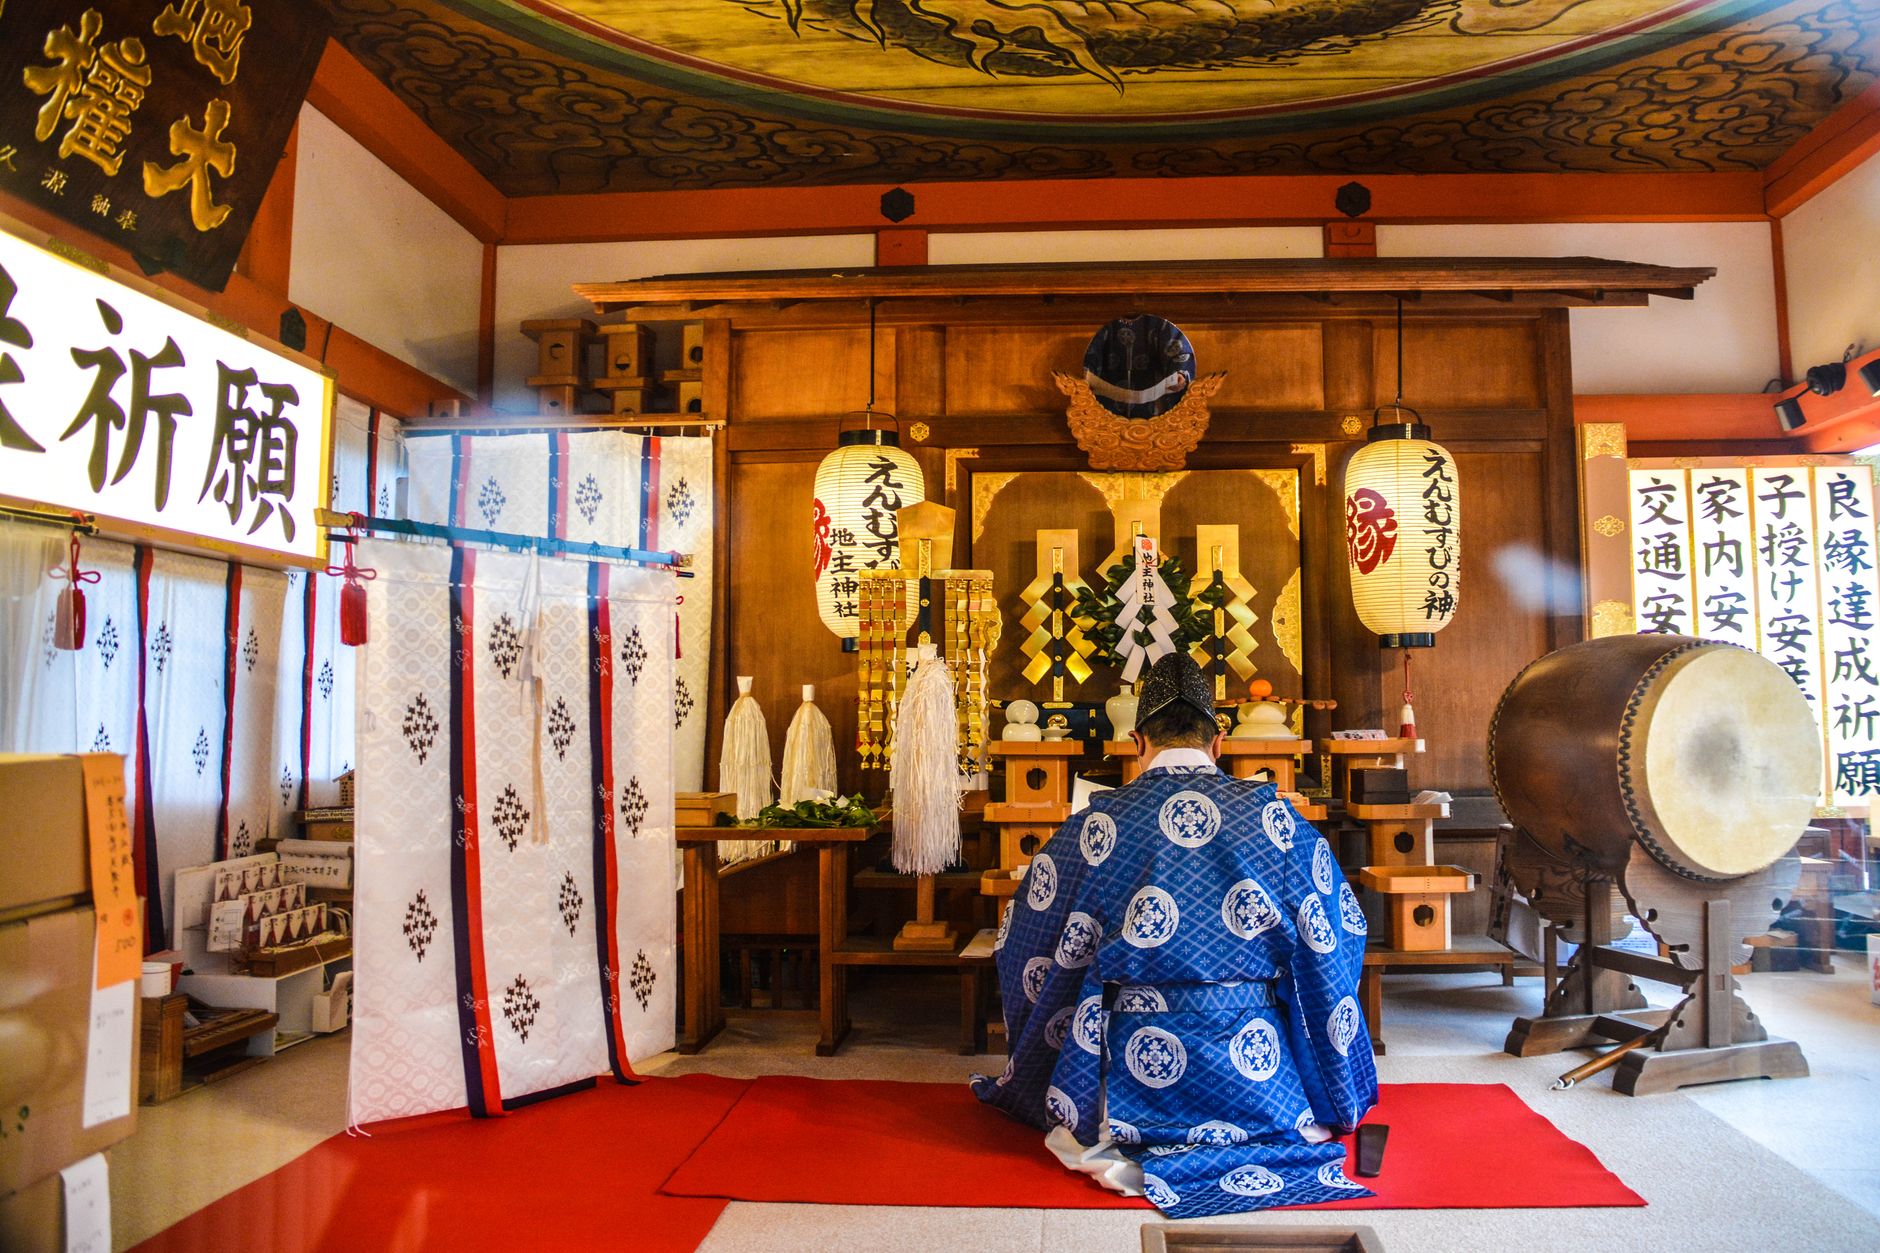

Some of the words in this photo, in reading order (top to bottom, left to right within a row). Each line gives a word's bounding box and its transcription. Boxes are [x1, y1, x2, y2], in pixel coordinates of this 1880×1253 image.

[830, 528, 859, 618] 地主神社
[1417, 449, 1454, 620] えんむすびの神
[1823, 472, 1880, 797] 良縁達成祈願
